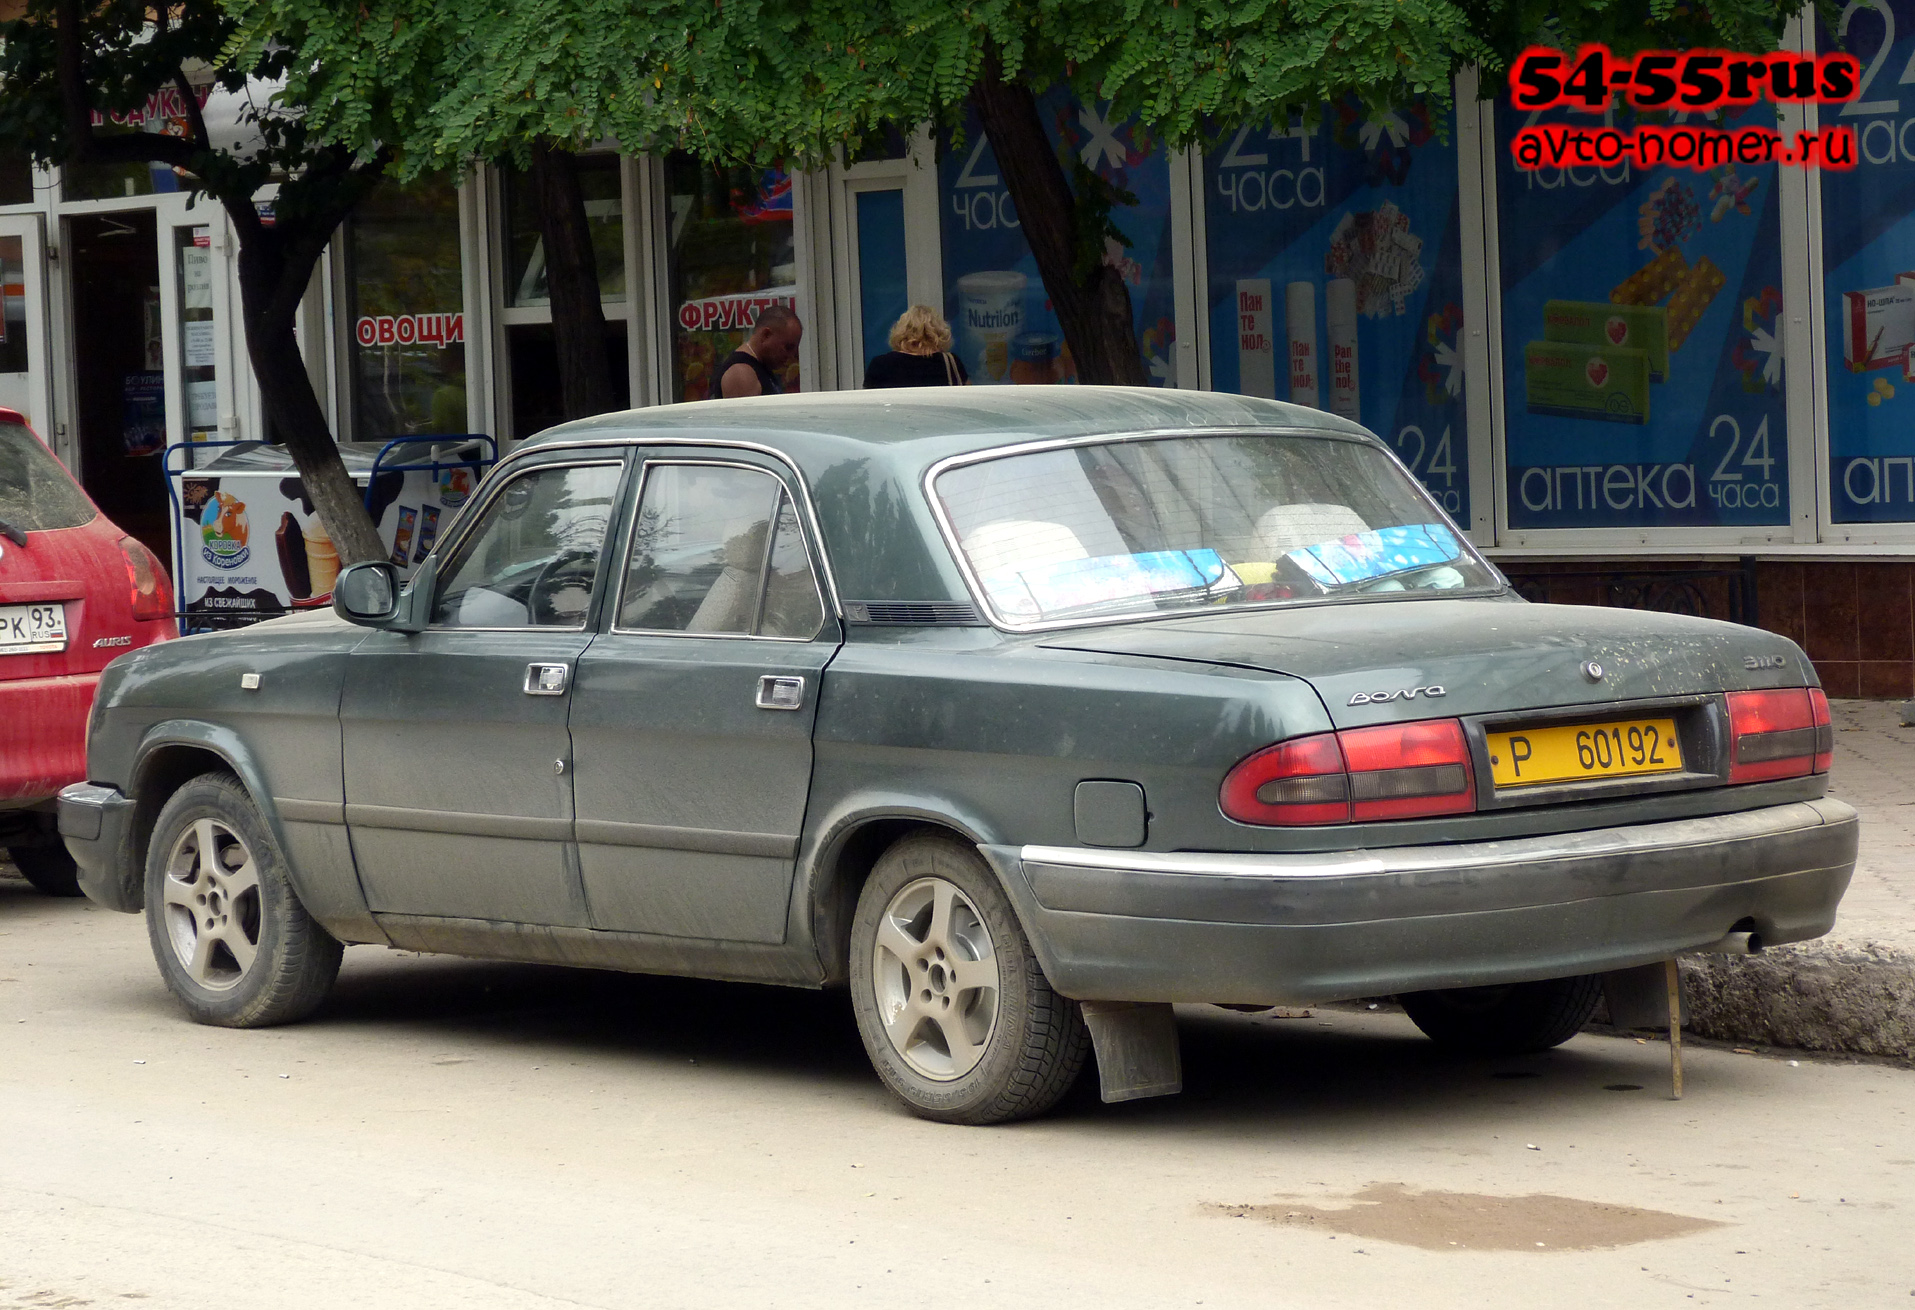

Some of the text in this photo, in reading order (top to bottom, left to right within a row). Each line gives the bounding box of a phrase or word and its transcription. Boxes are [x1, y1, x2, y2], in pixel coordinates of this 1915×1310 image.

[1218, 167, 1325, 212] часа
[953, 191, 1020, 230] час
[188, 254, 208, 264] Пиво
[1240, 292, 1262, 312] Пан
[968, 308, 1019, 328] Nutrilon
[1241, 315, 1255, 331] те
[357, 314, 464, 348] ОВОЩИ
[1242, 334, 1263, 350] нол
[1292, 341, 1310, 356] Пан
[1335, 344, 1352, 358] Pan
[1293, 359, 1304, 372] те
[1335, 361, 1351, 373] the
[1293, 374, 1311, 388] нол
[1336, 374, 1350, 388] nol
[1709, 413, 1775, 481] 24
[1398, 424, 1457, 488] 24
[1520, 463, 1696, 512] аптека
[1709, 482, 1779, 509] часа
[209, 540, 242, 550] КОРОВКА
[204, 596, 256, 608] ИЗ СВЕЖАЙШИХ
[31, 607, 56, 629] 93
[32, 630, 50, 639] RUS
[92, 635, 131, 649] AURIS
[1575, 725, 1664, 769] 60192
